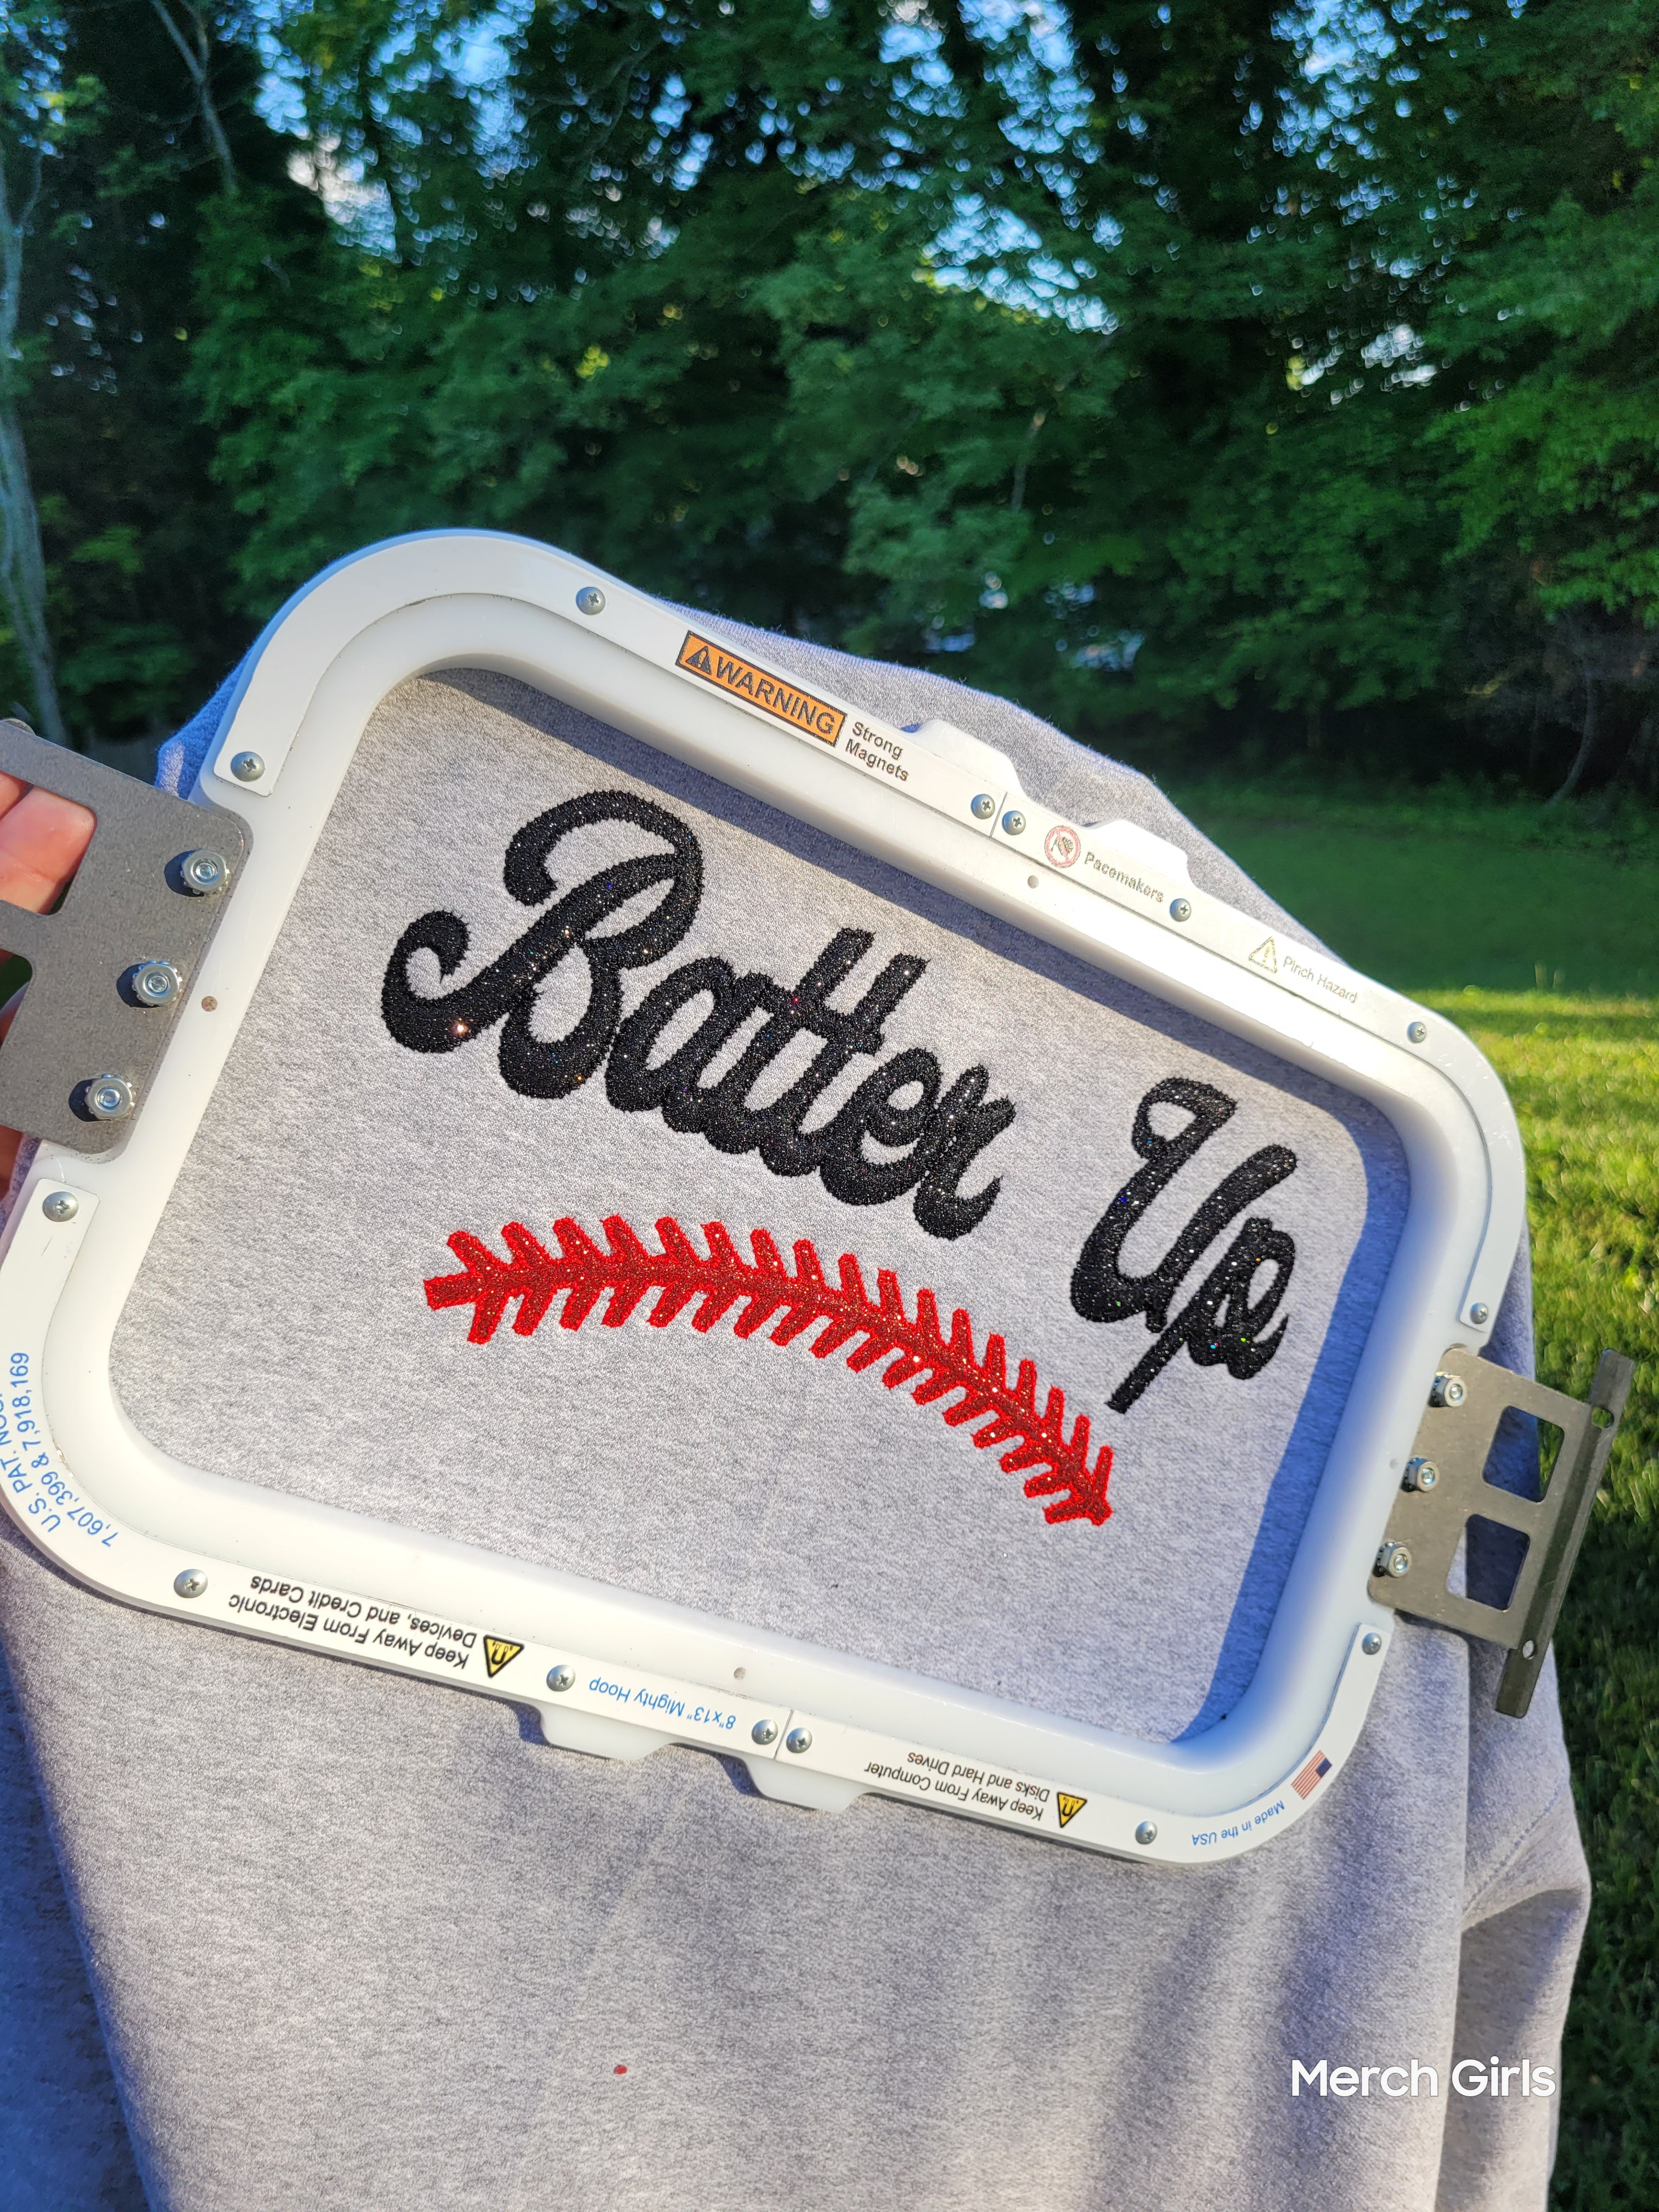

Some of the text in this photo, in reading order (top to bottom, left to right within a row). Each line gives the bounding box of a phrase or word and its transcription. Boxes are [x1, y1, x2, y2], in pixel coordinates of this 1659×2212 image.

[716, 657, 836, 736] WARNING
[845, 738, 908, 781] Magnets
[853, 721, 904, 759] Strong
[1084, 851, 1164, 903] Pacemakers
[1283, 956, 1357, 1004] Pinch Hazard
[381, 789, 1298, 1413] Batter Up
[10, 1352, 119, 1547] 7,607,399 & 7,918,169
[29, 1492, 61, 1532] U.S.
[229, 1594, 469, 1669] Keep Away From Electronic
[250, 1576, 477, 1647] Devices, and Credit Cards
[589, 1677, 736, 1729] 8"x13" Mighty Hoop
[864, 1761, 1044, 1821] Keep Away From Computer
[908, 1752, 1050, 1802] Disks and Hard Drives
[1192, 1801, 1285, 1846] Made in the USA
